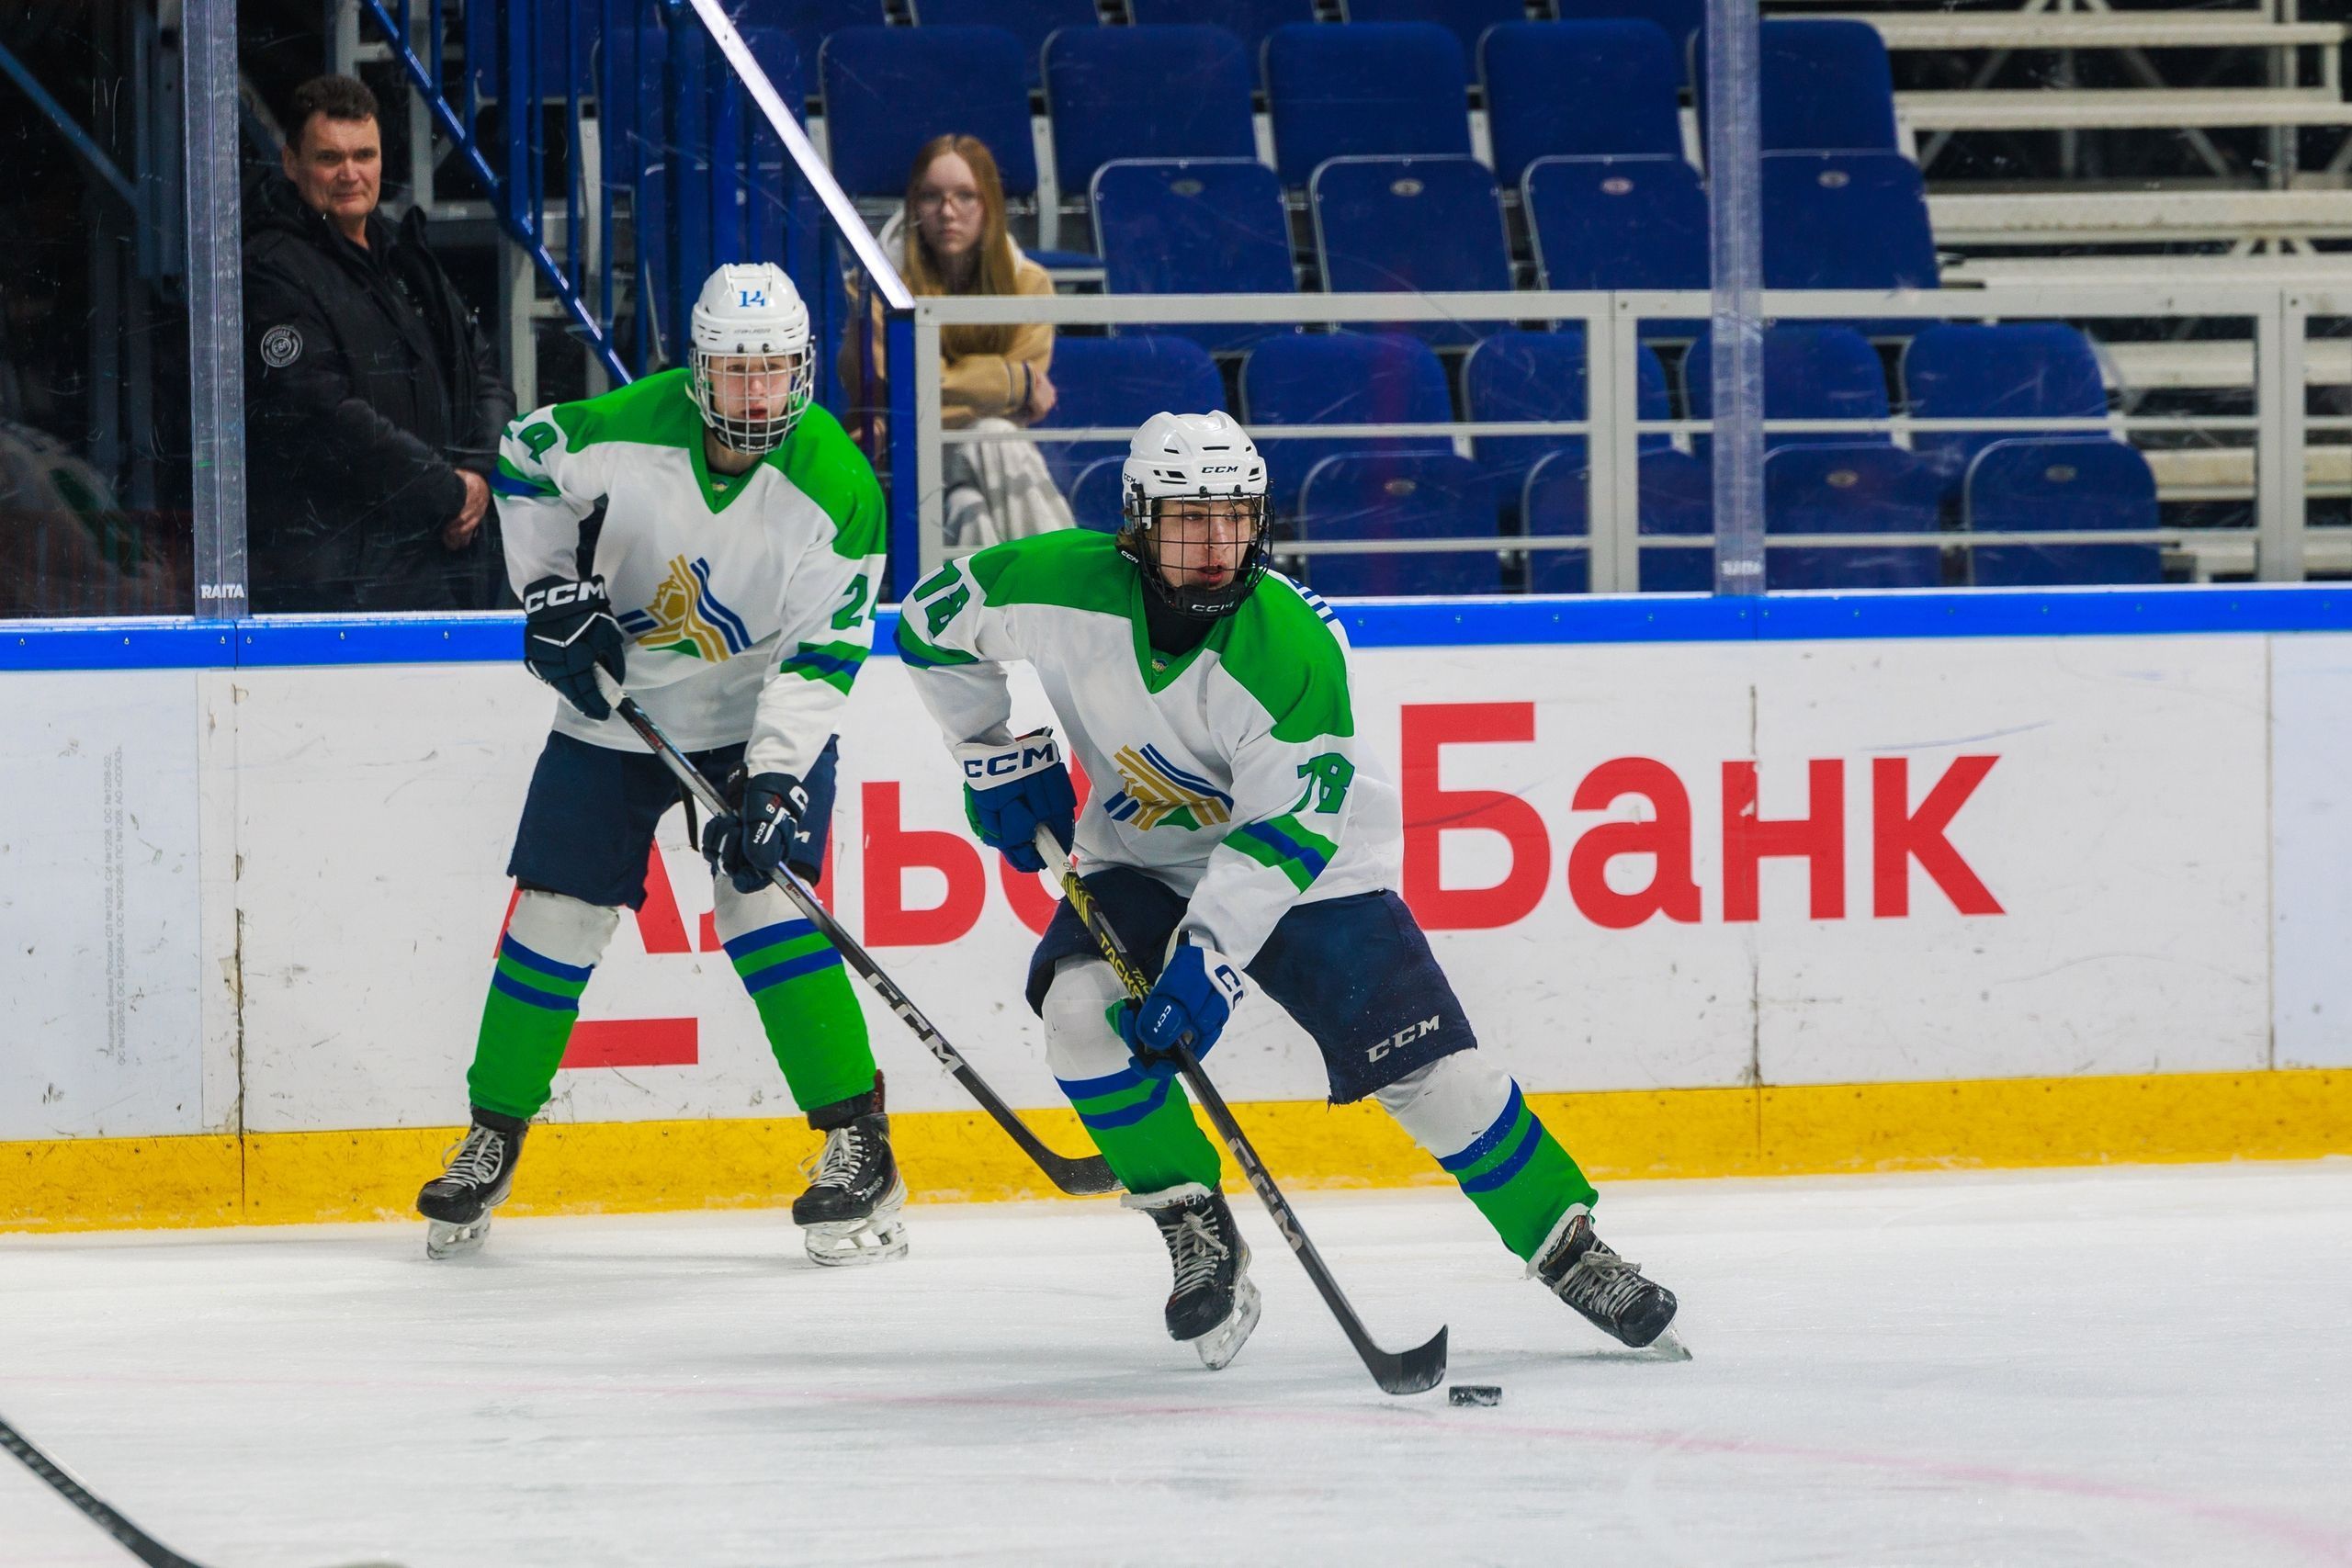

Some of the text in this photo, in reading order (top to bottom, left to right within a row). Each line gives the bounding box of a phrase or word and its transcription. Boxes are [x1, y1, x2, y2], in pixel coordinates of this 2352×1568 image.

[739, 290, 765, 308] 14
[1124, 473, 1136, 484] CCM
[1201, 466, 1238, 474] CCM
[1121, 550, 1139, 564] CCM
[201, 583, 244, 599] RAITA
[525, 581, 606, 615] CCM
[831, 573, 877, 631] 2
[913, 559, 971, 639] 78
[1192, 601, 1235, 613] CCM
[963, 742, 1055, 779] CCM
[115, 790, 123, 805] АО
[1288, 752, 1356, 815] 78
[104, 807, 112, 824] ОС
[1401, 702, 2007, 931] Банк
[753, 822, 767, 844] CCM
[116, 913, 125, 928] ОС
[106, 941, 114, 976] России
[1100, 931, 1144, 1000] TACKS
[106, 978, 114, 1007] Банка
[117, 982, 125, 998] ОС
[1132, 967, 1153, 995] TAC
[866, 973, 964, 1073] CCM
[1153, 1004, 1172, 1033] CCM
[1365, 1014, 1440, 1063] CCM
